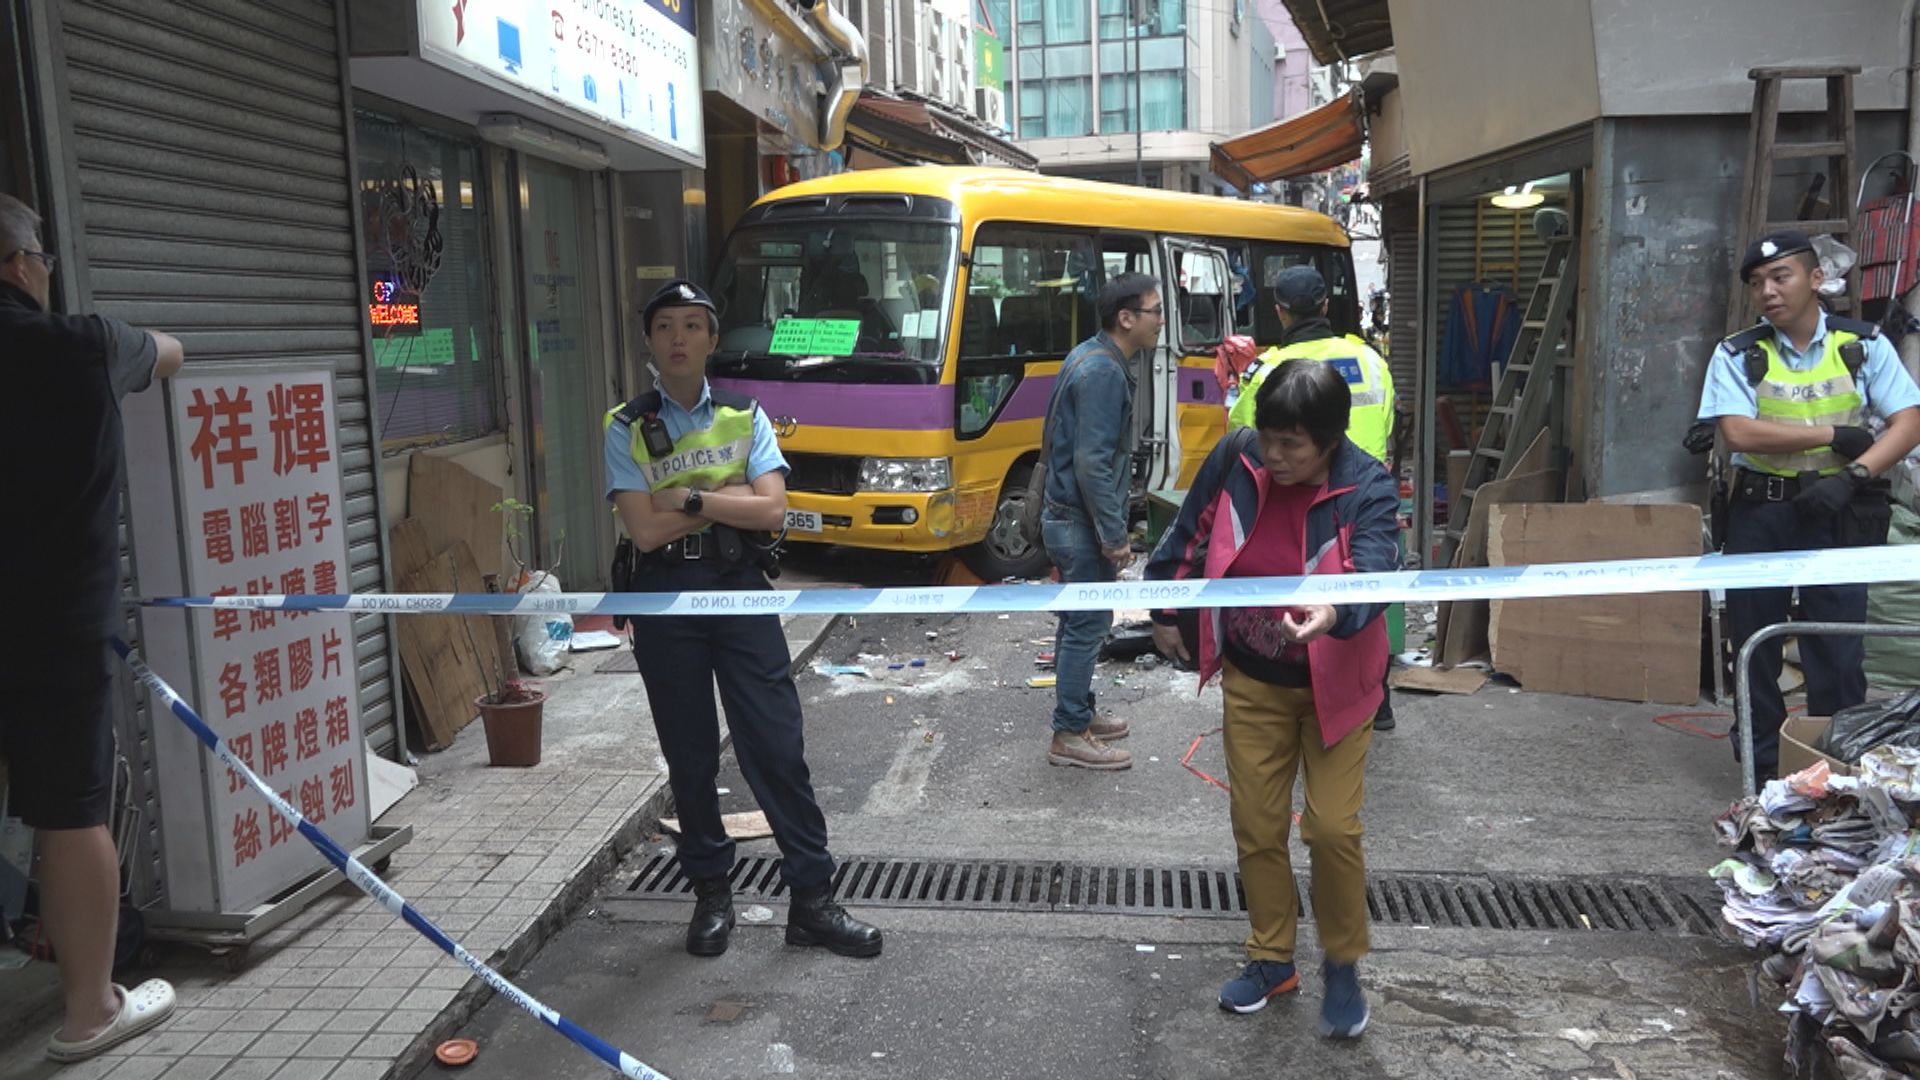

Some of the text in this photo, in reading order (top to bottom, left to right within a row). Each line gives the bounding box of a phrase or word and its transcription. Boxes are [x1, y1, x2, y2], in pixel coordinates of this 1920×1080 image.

[576, 25, 605, 61] 2571
[369, 304, 419, 325] WELCOME
[187, 383, 331, 489] 祥輝
[663, 449, 715, 477] POLICE
[203, 492, 332, 565] 電腦割字
[218, 628, 342, 719] 各類膠片
[227, 695, 350, 794] 招牌燈箱
[232, 758, 355, 868] 絲印蝕刻
